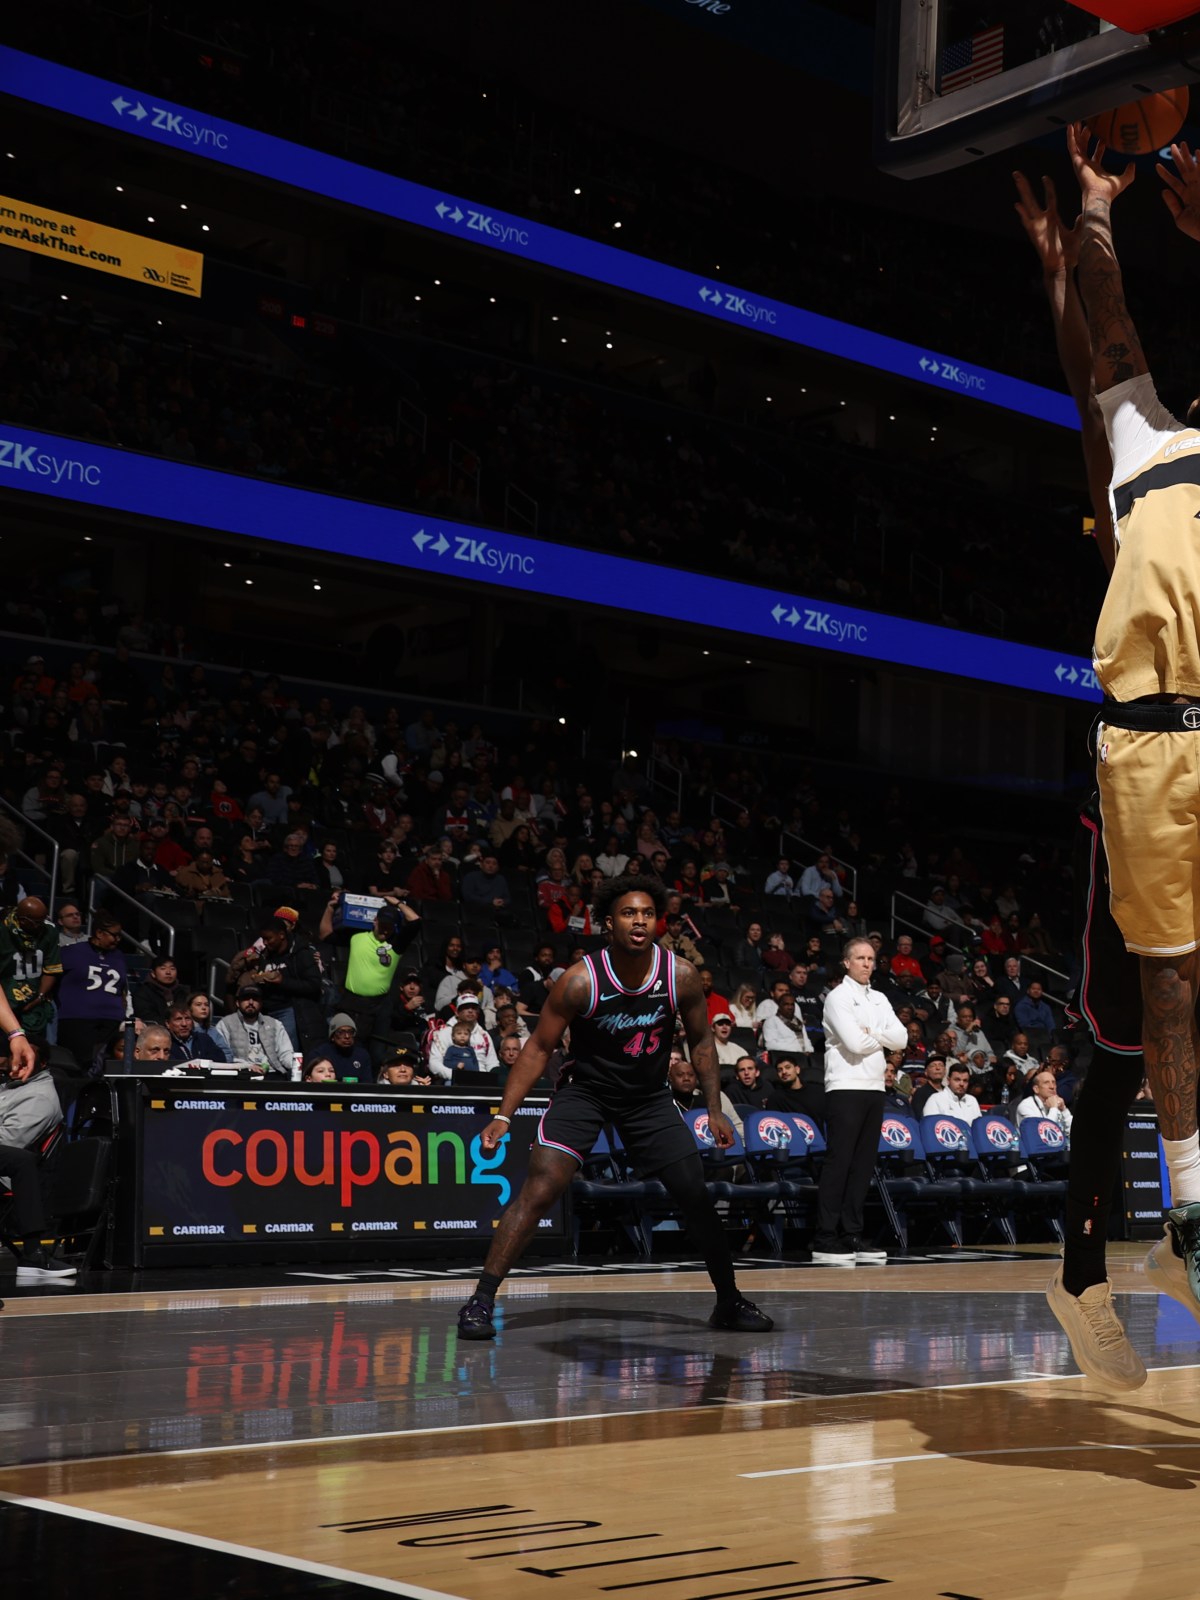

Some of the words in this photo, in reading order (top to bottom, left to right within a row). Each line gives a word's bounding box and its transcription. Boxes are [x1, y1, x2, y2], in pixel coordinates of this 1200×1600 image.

[684, 0, 731, 15] ne
[151, 106, 229, 150] ZKsync
[0, 207, 16, 219] rn
[20, 212, 58, 231] more
[61, 223, 77, 237] at
[466, 209, 529, 246] ZKsync
[724, 292, 777, 325] ZKsync
[940, 362, 987, 391] ZKsync
[0, 438, 101, 486] ZKsync
[454, 535, 535, 575] ZKsync
[803, 608, 868, 643] ZKsync
[86, 965, 120, 995] 52
[594, 1004, 666, 1036] Miami
[623, 1026, 664, 1057] 45
[202, 1128, 511, 1207] coupang
[318, 1503, 981, 1600] DITION
